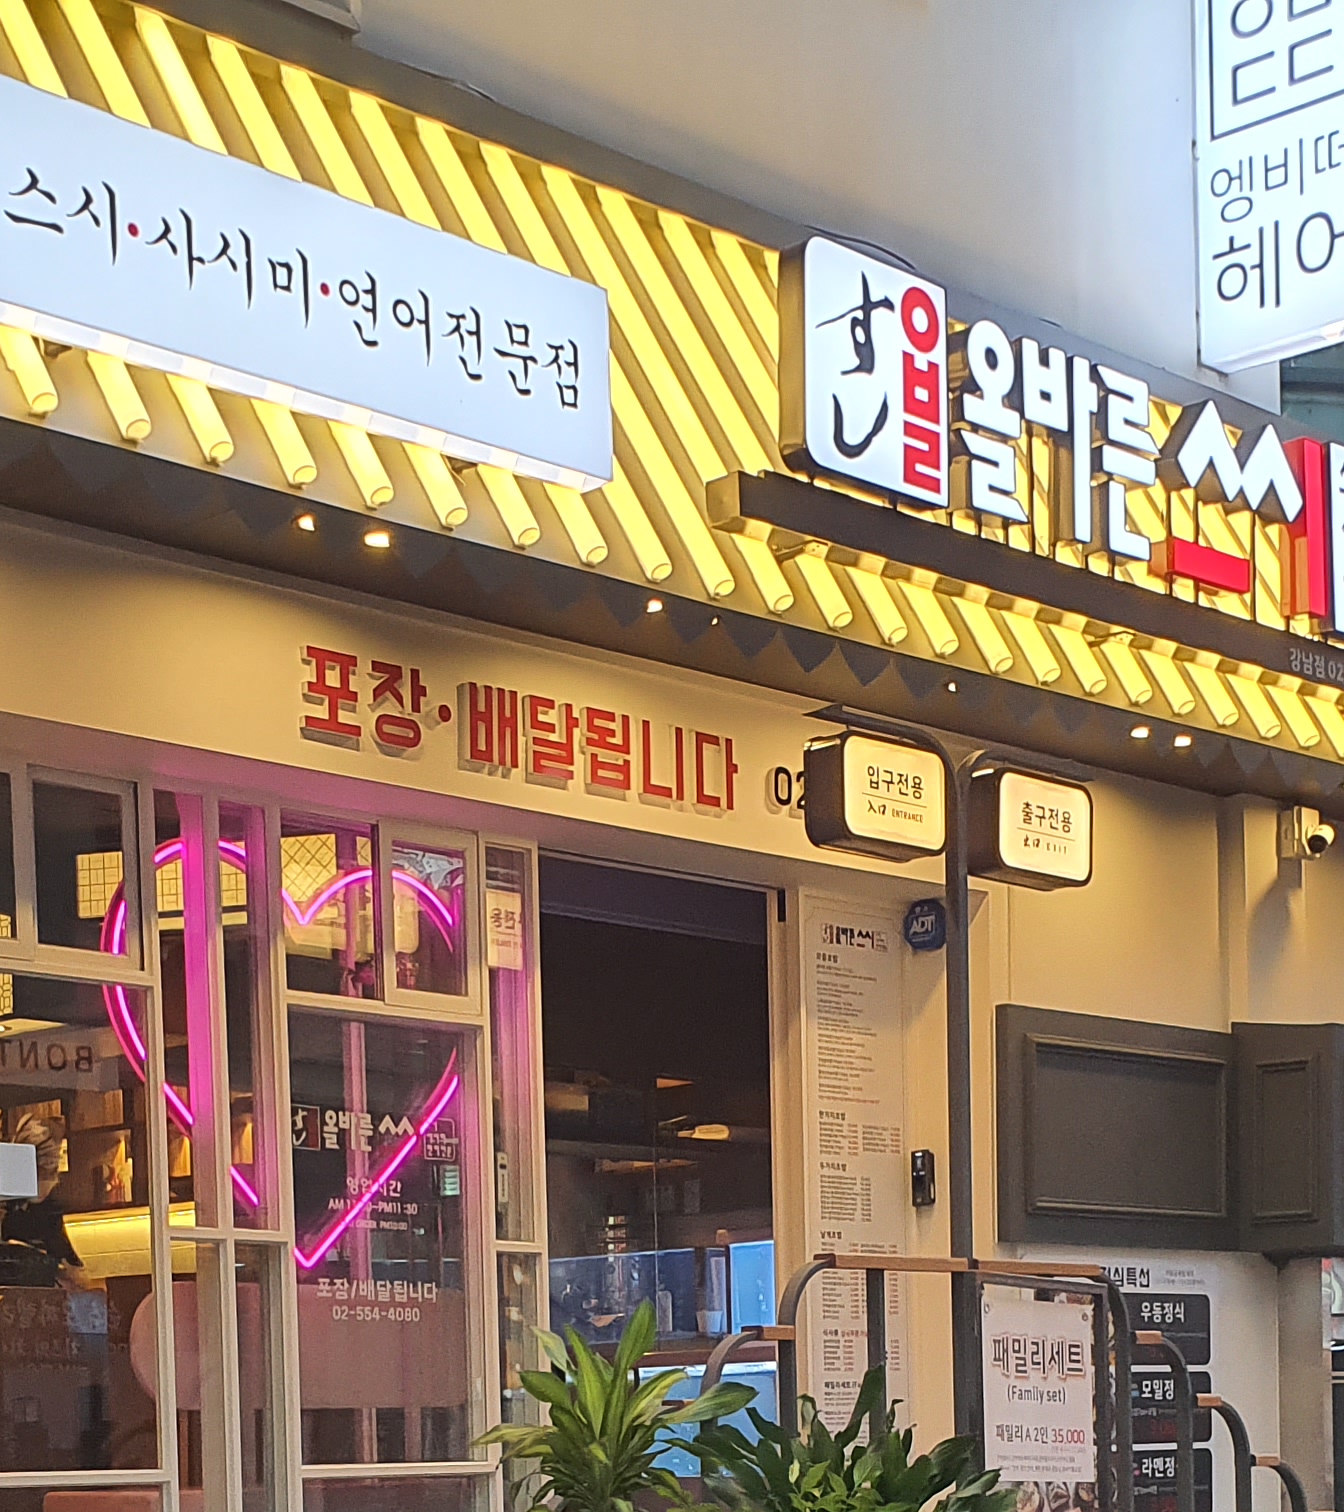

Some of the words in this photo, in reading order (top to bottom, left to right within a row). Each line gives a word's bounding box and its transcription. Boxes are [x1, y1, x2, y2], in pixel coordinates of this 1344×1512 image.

[867, 765, 925, 800] 입구전용
[1022, 802, 1073, 833] 출구전용
[910, 915, 936, 935] ADT
[332, 1305, 421, 1322] 02-554-4080
[992, 1336, 1084, 1376] 패밀리세트
[1007, 1385, 1044, 1405] (Family
[1047, 1387, 1066, 1404] set)
[1141, 1379, 1174, 1400] 모밀정
[1142, 1457, 1179, 1478] 라멘정
